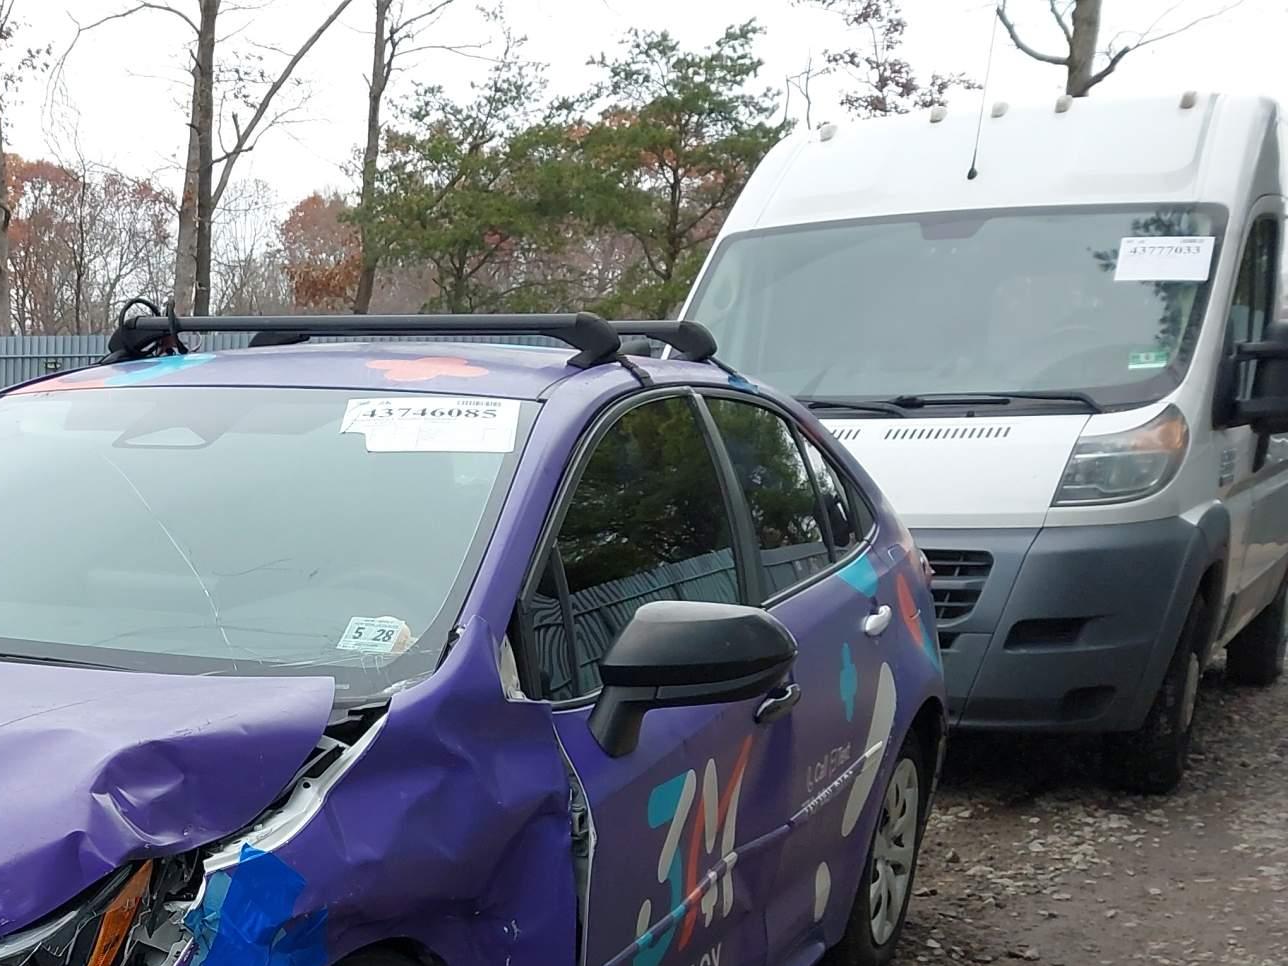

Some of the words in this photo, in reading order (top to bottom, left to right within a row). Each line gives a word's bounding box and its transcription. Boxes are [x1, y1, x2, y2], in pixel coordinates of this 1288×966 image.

[362, 407, 497, 419] 43746085
[352, 626, 366, 640] 5
[371, 628, 395, 643] 28
